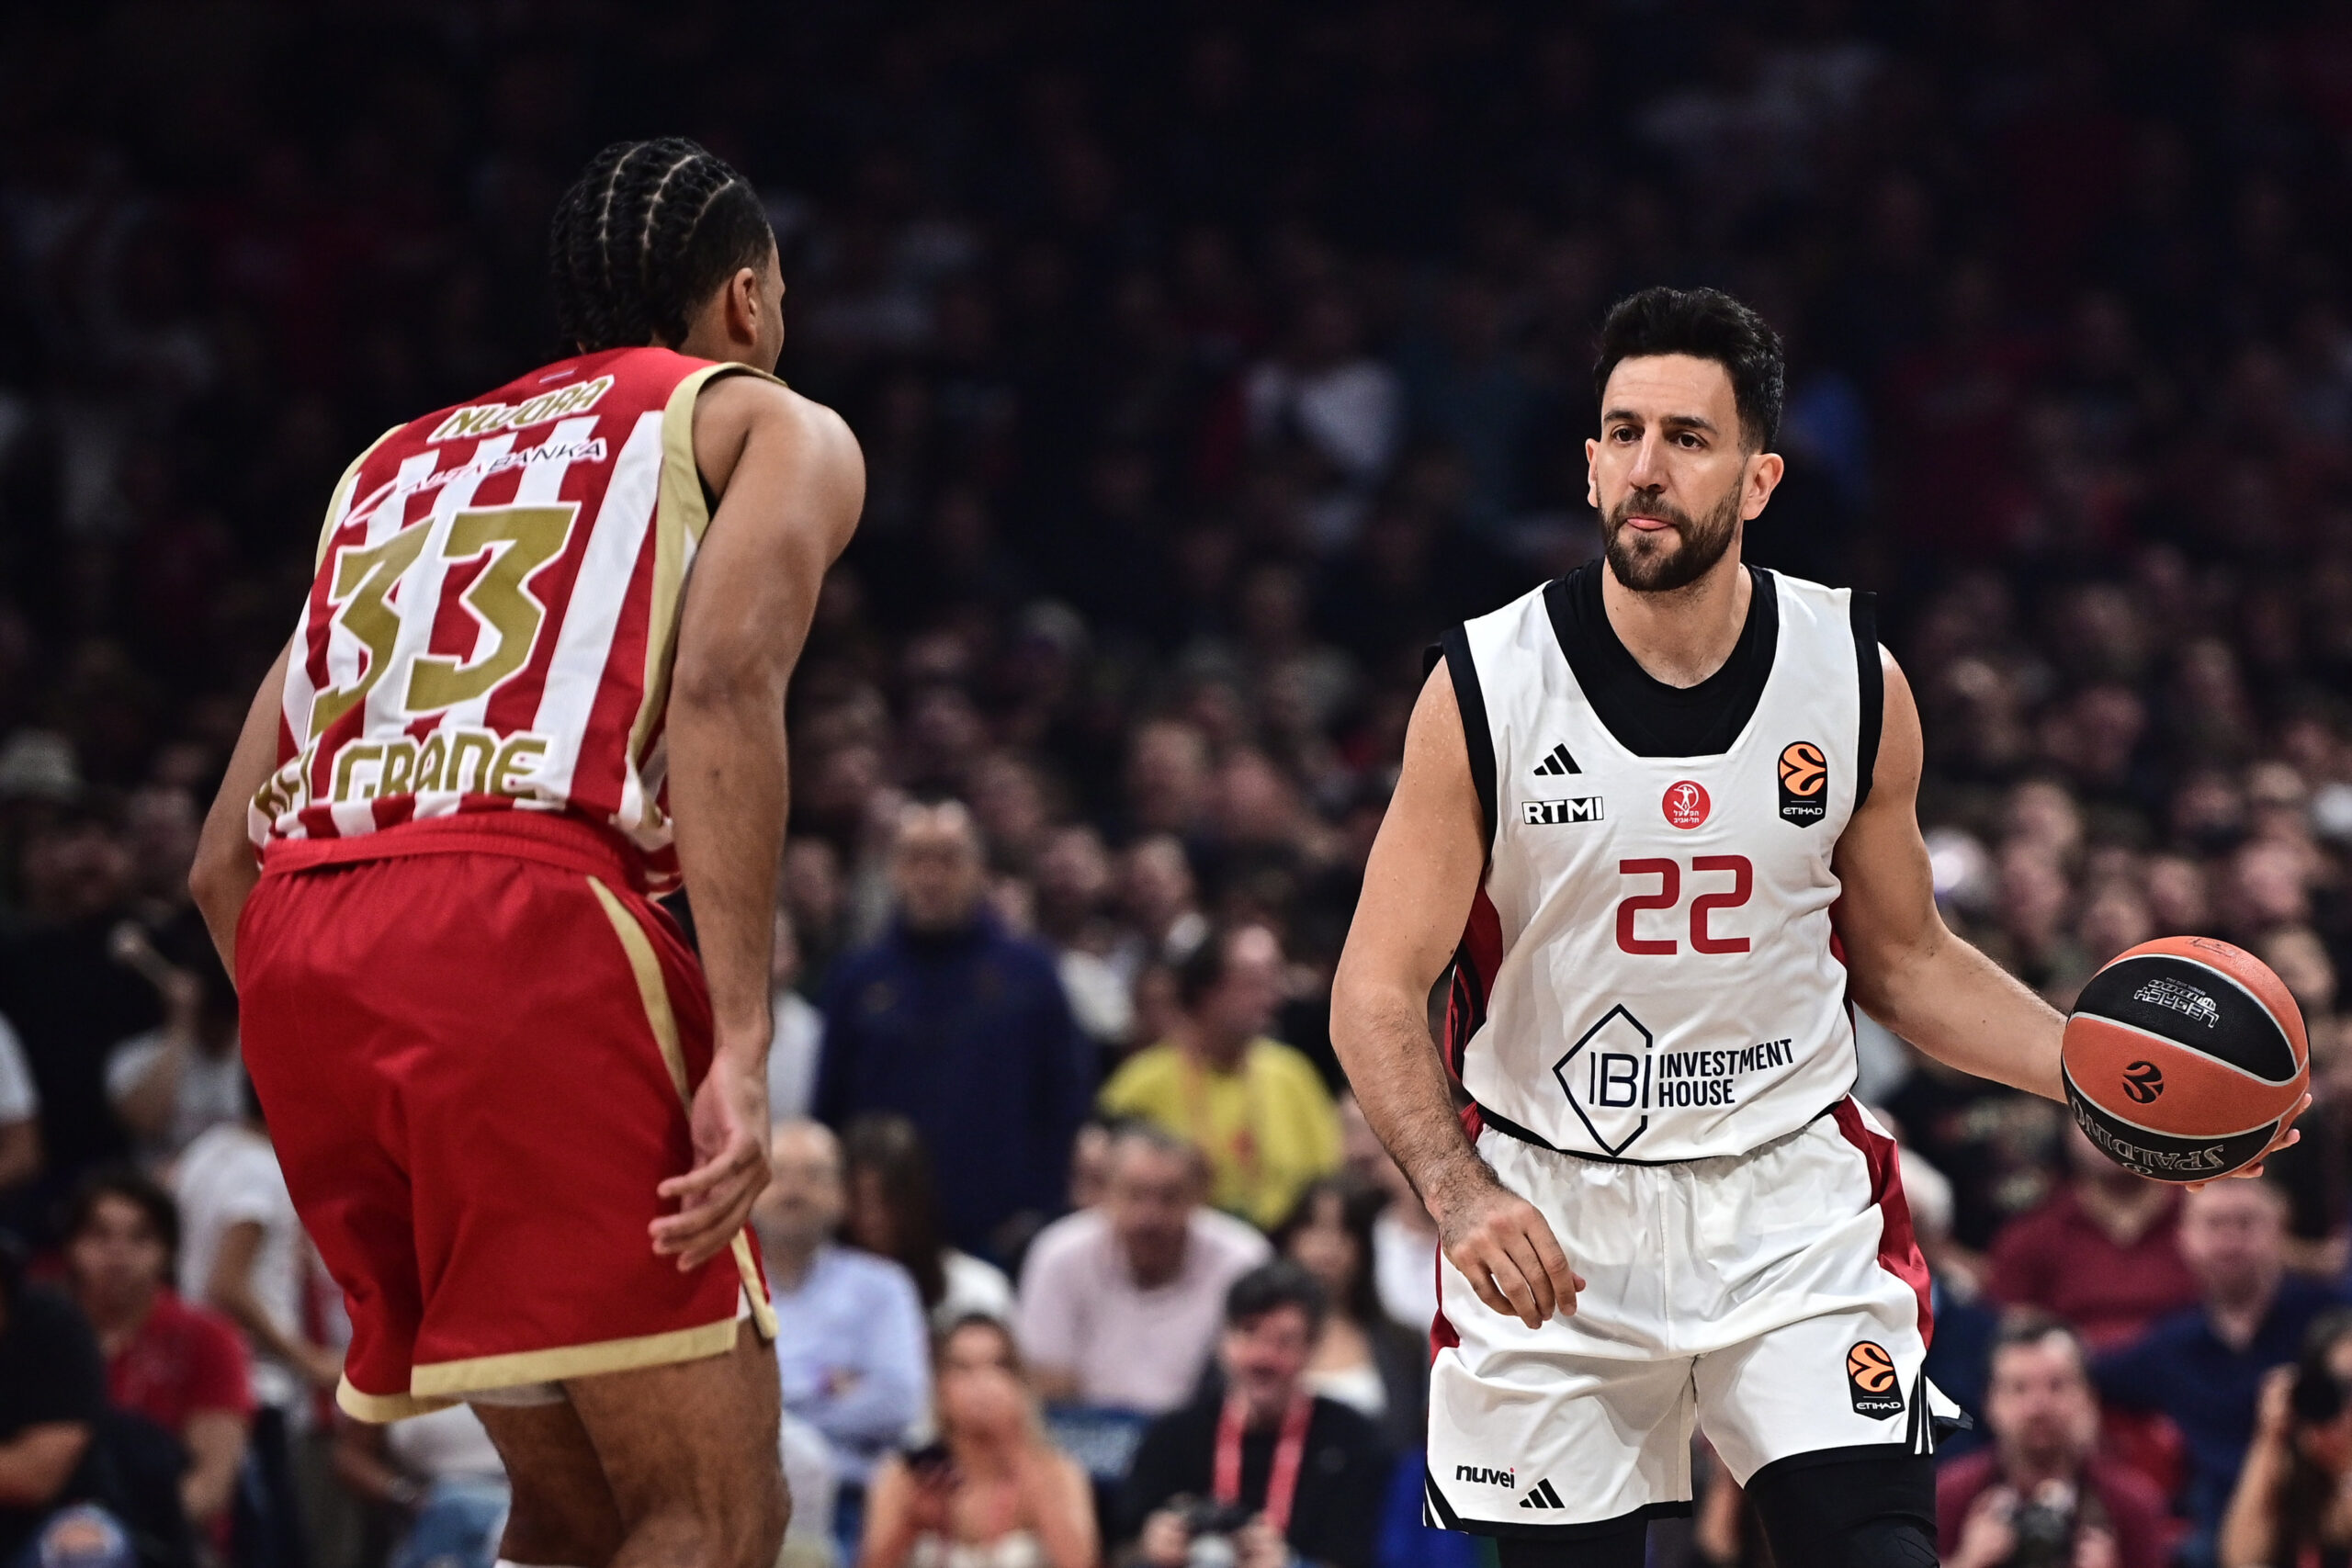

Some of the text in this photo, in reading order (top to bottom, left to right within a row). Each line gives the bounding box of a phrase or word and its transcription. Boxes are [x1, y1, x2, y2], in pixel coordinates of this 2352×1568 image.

[309, 502, 581, 740] 33
[1522, 796, 1603, 824] RTMI
[1782, 807, 1824, 816] ETIHAD
[1616, 854, 1753, 955] 22
[2133, 987, 2220, 1028] LEGACY
[1659, 1038, 1794, 1079] INVESTMENT
[1658, 1078, 1736, 1108] HOUSE
[2071, 1095, 2224, 1171] SPALDING
[1856, 1401, 1902, 1410] ETIHAD
[1455, 1464, 1515, 1489] nuvei
